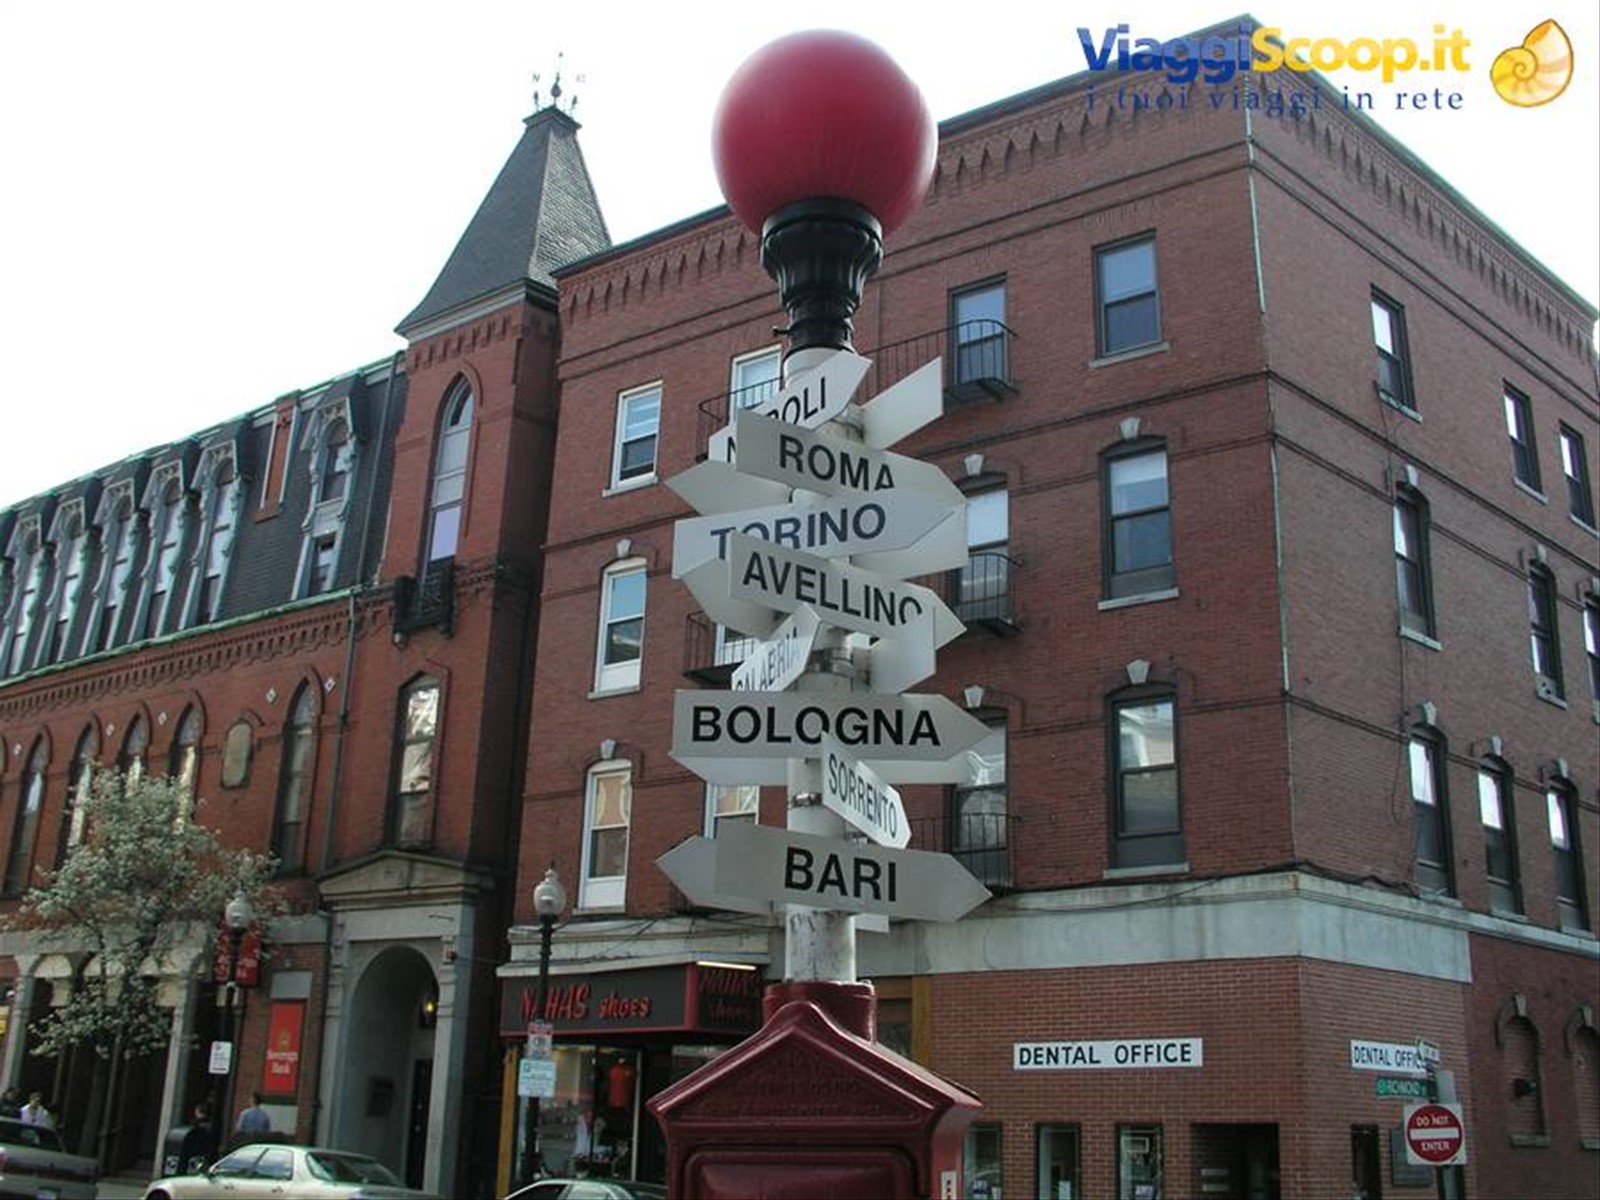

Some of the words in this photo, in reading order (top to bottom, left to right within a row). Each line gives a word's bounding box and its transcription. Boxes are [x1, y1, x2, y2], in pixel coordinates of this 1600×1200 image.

[779, 433, 895, 491] ROMA
[710, 503, 886, 561] TORINO
[742, 552, 922, 626] AVELLINO
[691, 705, 941, 746] BOLOGNA
[828, 753, 898, 839] SORRENTO
[784, 846, 897, 902] BARI
[1019, 1047, 1101, 1065] DENTAL
[1114, 1043, 1192, 1064] OFFICE
[1354, 1046, 1391, 1066] DENTAL
[1395, 1050, 1424, 1069] OFFIC
[1416, 1115, 1430, 1127] DO
[1431, 1113, 1449, 1126] NOT
[1421, 1141, 1450, 1151] ENTER
